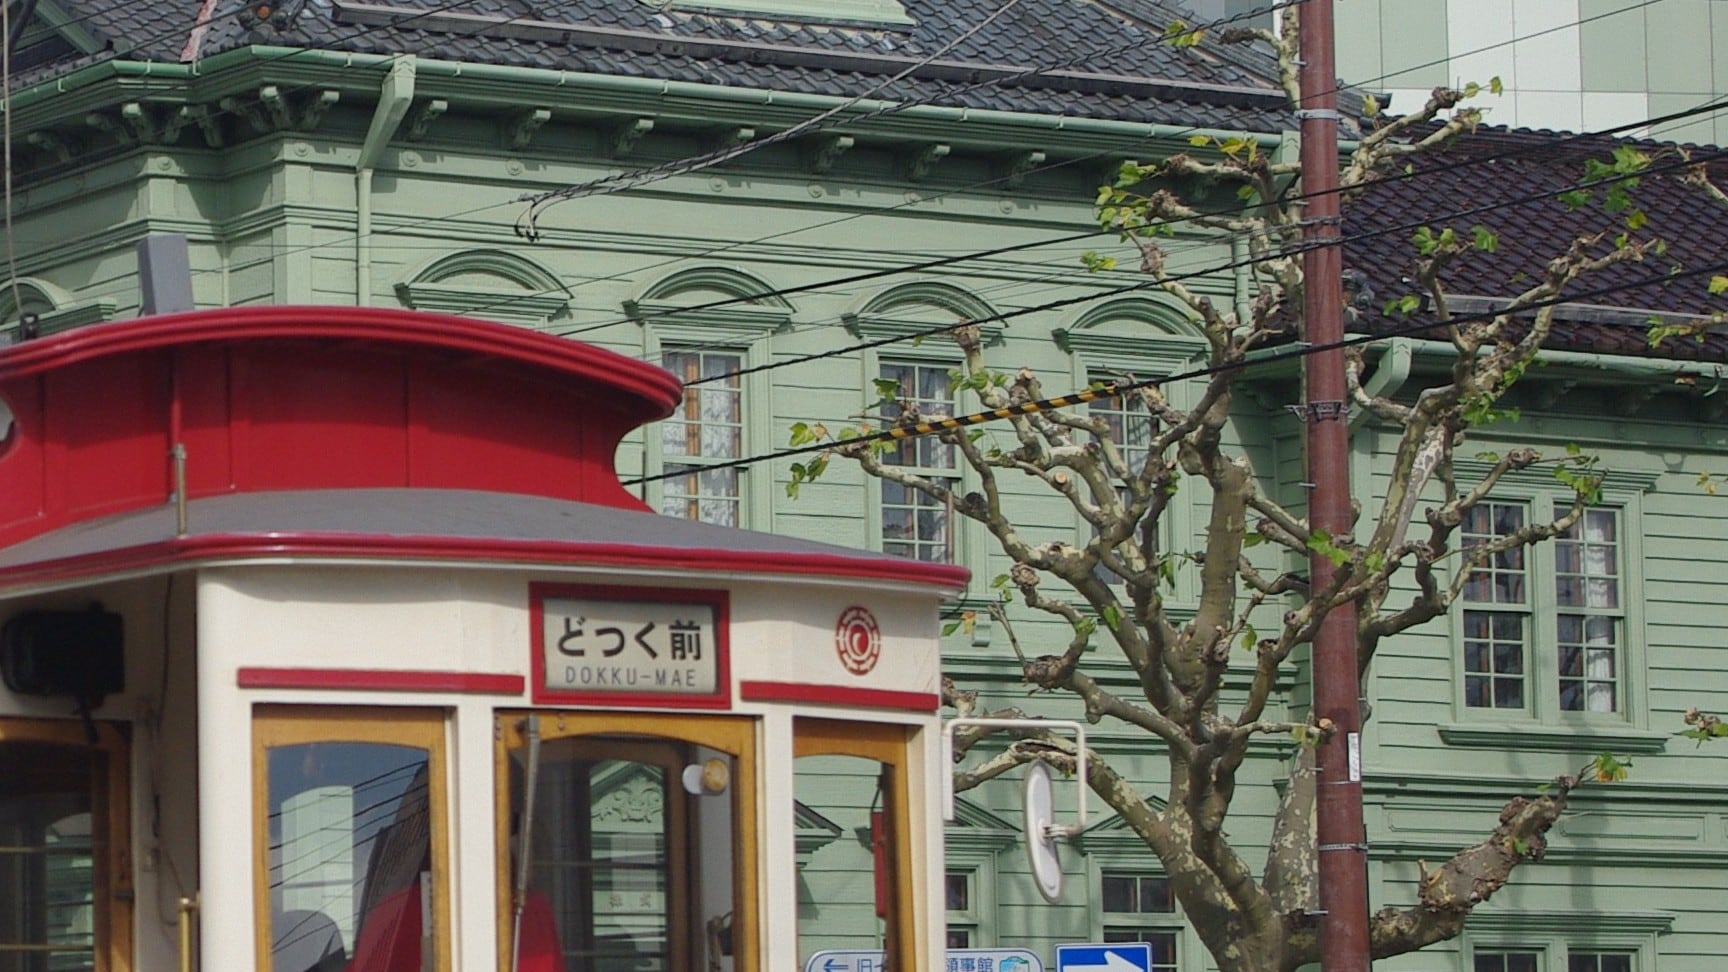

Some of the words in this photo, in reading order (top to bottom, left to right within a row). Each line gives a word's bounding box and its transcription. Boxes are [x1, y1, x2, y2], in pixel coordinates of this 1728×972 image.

[557, 615, 702, 662] どつく前
[565, 665, 697, 687] DOKKU-MAE
